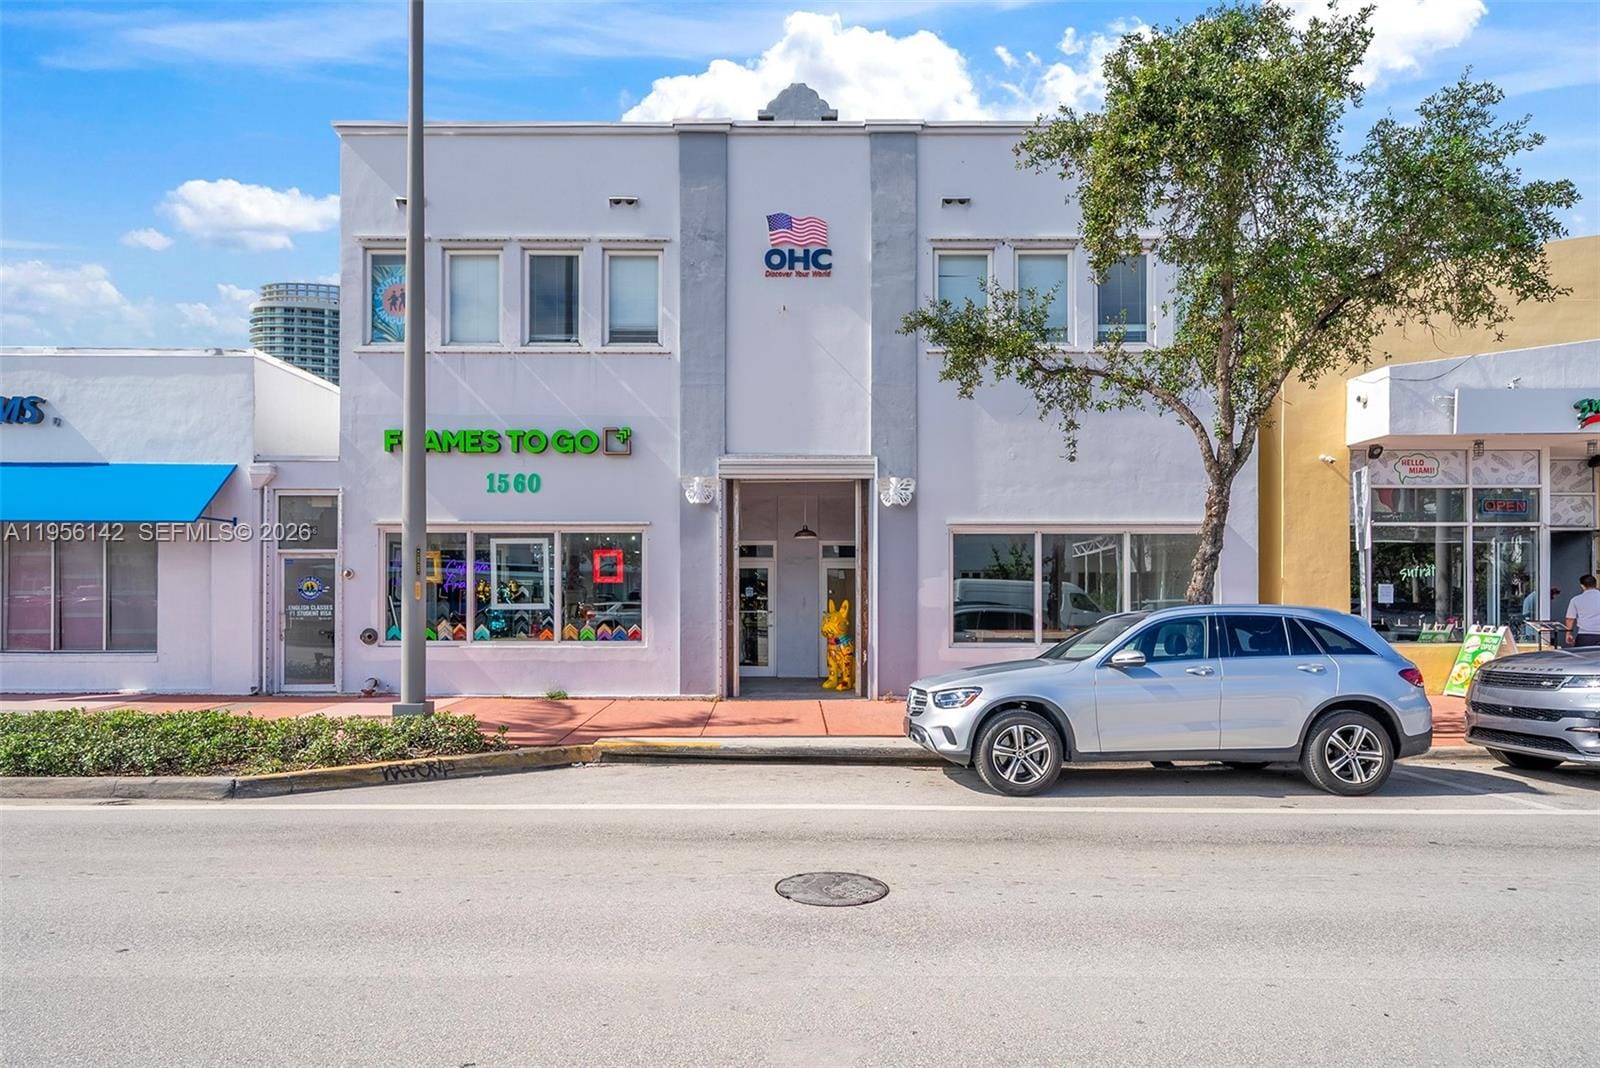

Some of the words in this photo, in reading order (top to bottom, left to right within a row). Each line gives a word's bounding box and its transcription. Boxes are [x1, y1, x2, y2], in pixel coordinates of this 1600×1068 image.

[764, 248, 833, 270] OHC
[765, 270, 793, 278] Discover
[795, 270, 810, 278] Your
[812, 270, 832, 278] World
[374, 276, 401, 299] SOUTH
[384, 429, 500, 454] FAMES
[505, 429, 549, 454] TO
[551, 429, 600, 454] GO
[486, 472, 542, 494] 1560
[1485, 501, 1526, 512] OPEN
